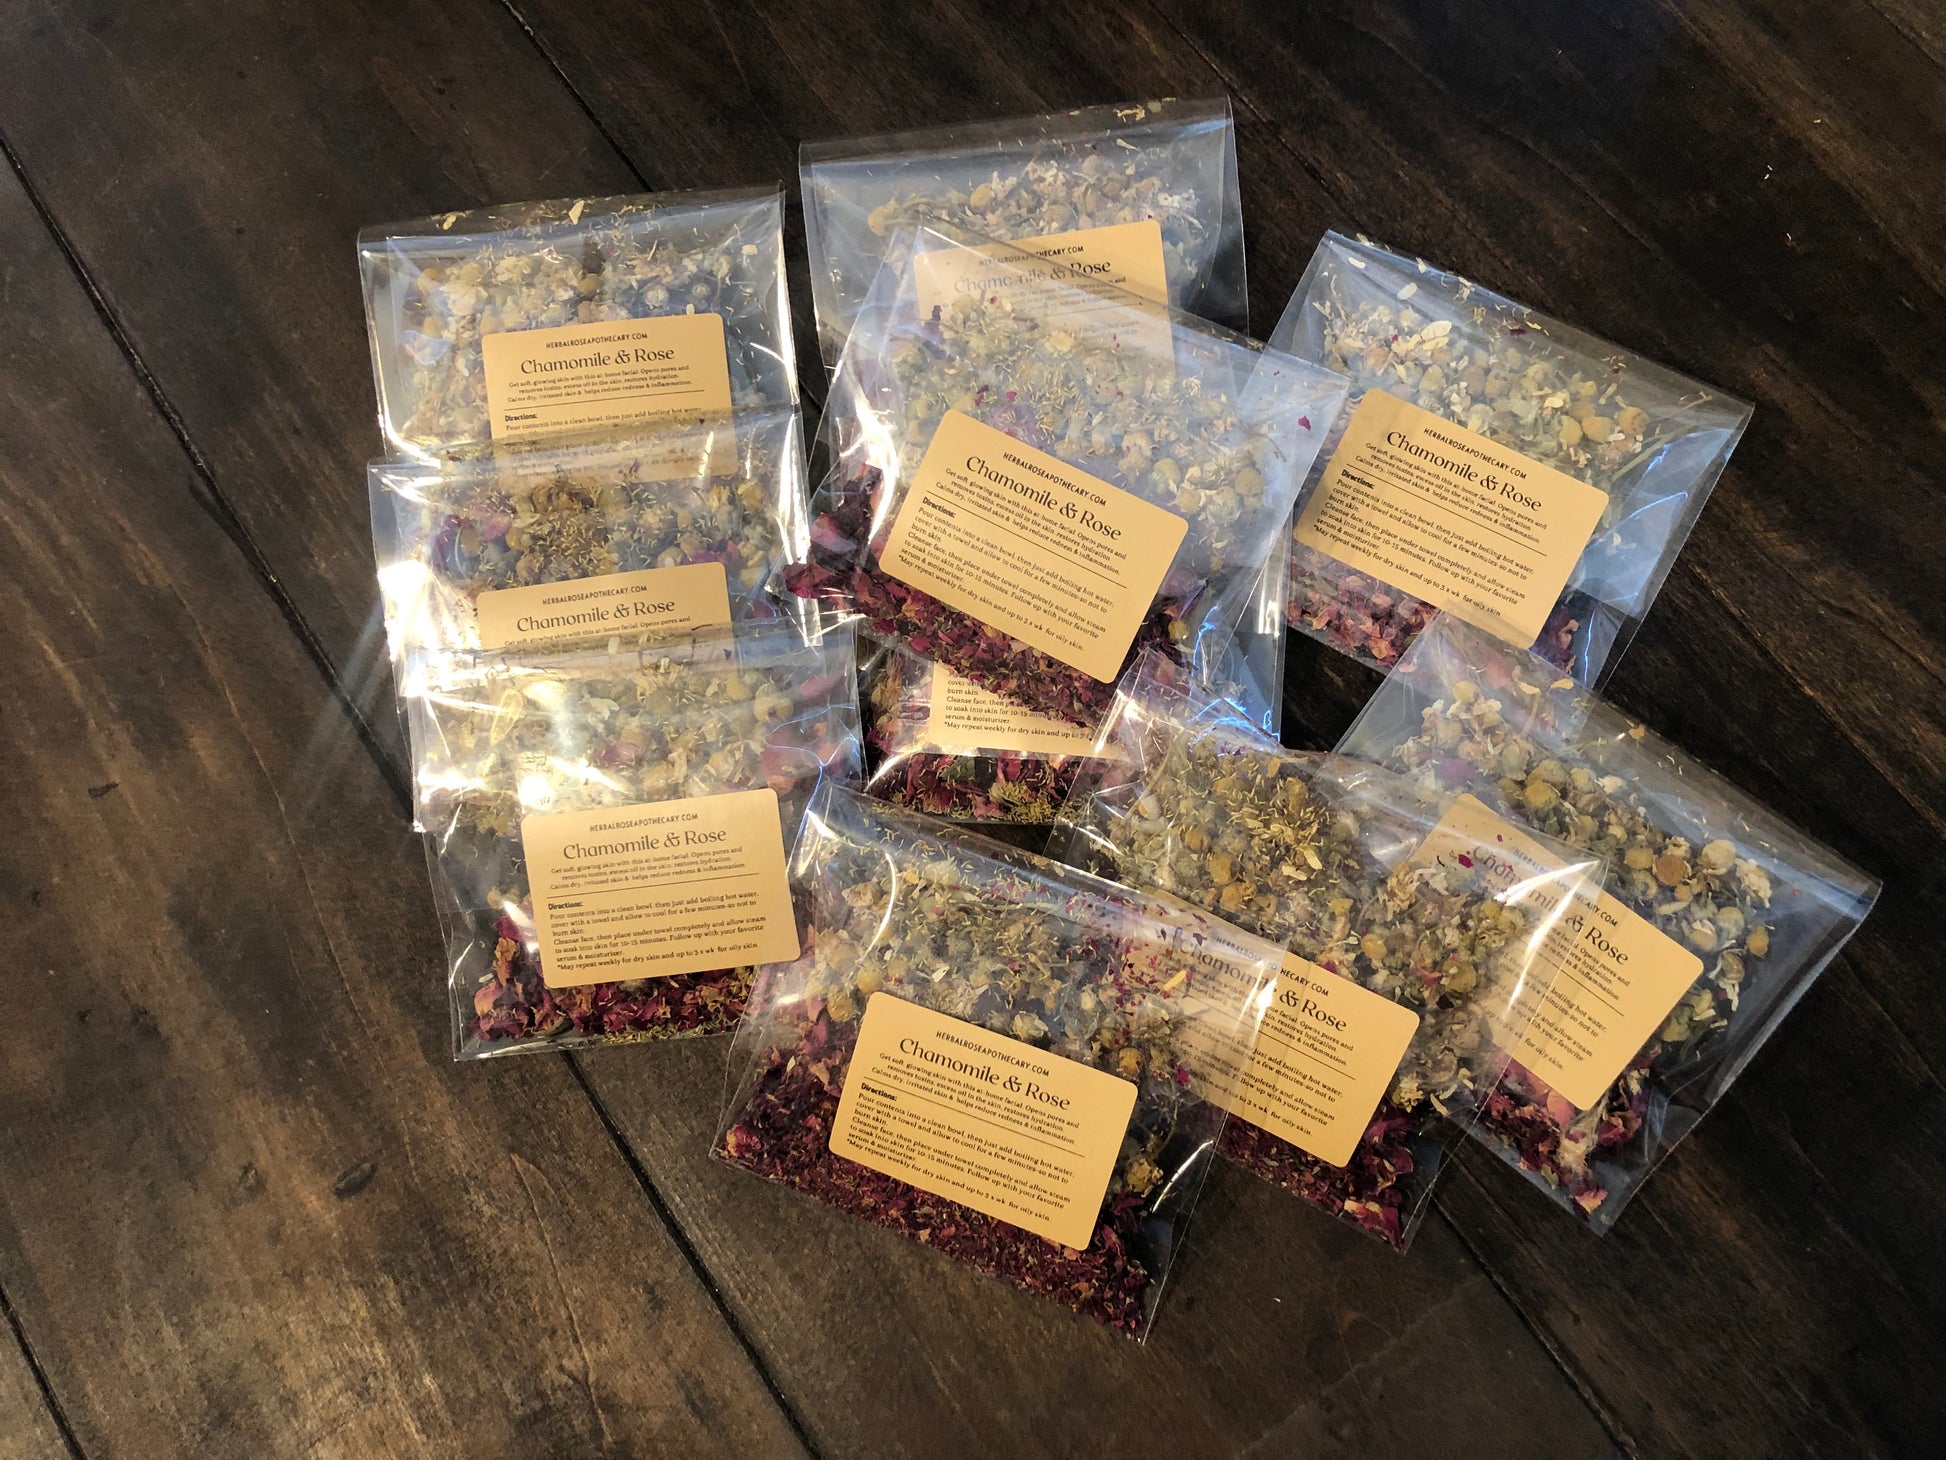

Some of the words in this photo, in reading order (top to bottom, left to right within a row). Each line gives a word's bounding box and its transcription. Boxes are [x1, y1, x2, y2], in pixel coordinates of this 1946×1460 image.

[1070, 262, 1111, 278] Rose
[520, 352, 611, 374] Chamomile
[614, 349, 631, 365] &
[634, 347, 674, 363] Rose
[504, 413, 538, 422] Directions:
[1340, 469, 1375, 490] Directions:
[1386, 431, 1479, 482] Chamomile
[1479, 473, 1500, 491] &
[1499, 482, 1542, 511] Rose
[922, 496, 956, 519] Directions:
[966, 455, 1059, 510] Chamomile
[1059, 501, 1079, 520] &
[1079, 509, 1122, 541] Rose
[1327, 513, 1343, 524] soak
[1343, 519, 1357, 530] into
[1357, 526, 1371, 537] skin
[1371, 532, 1382, 542] for
[1428, 559, 1450, 574] Follow
[1460, 575, 1476, 586] with
[1475, 582, 1492, 594] your
[1492, 589, 1518, 606] favorite
[516, 606, 610, 632] Chamomile
[613, 603, 630, 619] &
[633, 600, 675, 616] Rose
[563, 834, 660, 860] Chamomile
[663, 832, 681, 848] &
[684, 828, 726, 846] Rose
[548, 901, 583, 911] Directions:
[1584, 926, 1630, 965] Rose
[1279, 989, 1300, 1008] &
[1301, 998, 1348, 1032] Rose
[899, 1038, 1000, 1085] Chamomile
[1002, 1074, 1023, 1093] &
[1025, 1082, 1071, 1111] Rose
[1252, 1047, 1267, 1059] just
[1267, 1056, 1282, 1067] add
[1282, 1062, 1308, 1080] boiling
[1308, 1075, 1321, 1086] hot
[861, 1082, 898, 1102] Directions:
[1279, 1089, 1294, 1100] and
[1294, 1097, 1314, 1110] allow
[1314, 1107, 1336, 1122] steam
[1314, 1089, 1328, 1099] not
[1266, 1092, 1282, 1104] with
[1282, 1100, 1300, 1112] your
[1300, 1108, 1328, 1127] favorite
[1270, 1111, 1281, 1120] for
[1282, 1118, 1296, 1128] oily
[856, 1101, 875, 1112] cover
[876, 1108, 892, 1118] with
[898, 1116, 917, 1128] towel
[918, 1124, 932, 1133] and
[932, 1129, 952, 1140] allow
[960, 1140, 976, 1150] cool
[976, 1145, 987, 1154] for
[994, 1152, 1006, 1161] few
[1047, 1172, 1060, 1181] not
[852, 1116, 879, 1131] Cleanse
[896, 1133, 912, 1144] then
[913, 1140, 932, 1151] place
[933, 1147, 954, 1160] under
[954, 1155, 974, 1167] towel
[974, 1163, 1013, 1183] completely
[1014, 1178, 1028, 1188] and
[1029, 1183, 1048, 1195] allow
[1049, 1191, 1071, 1204] steam
